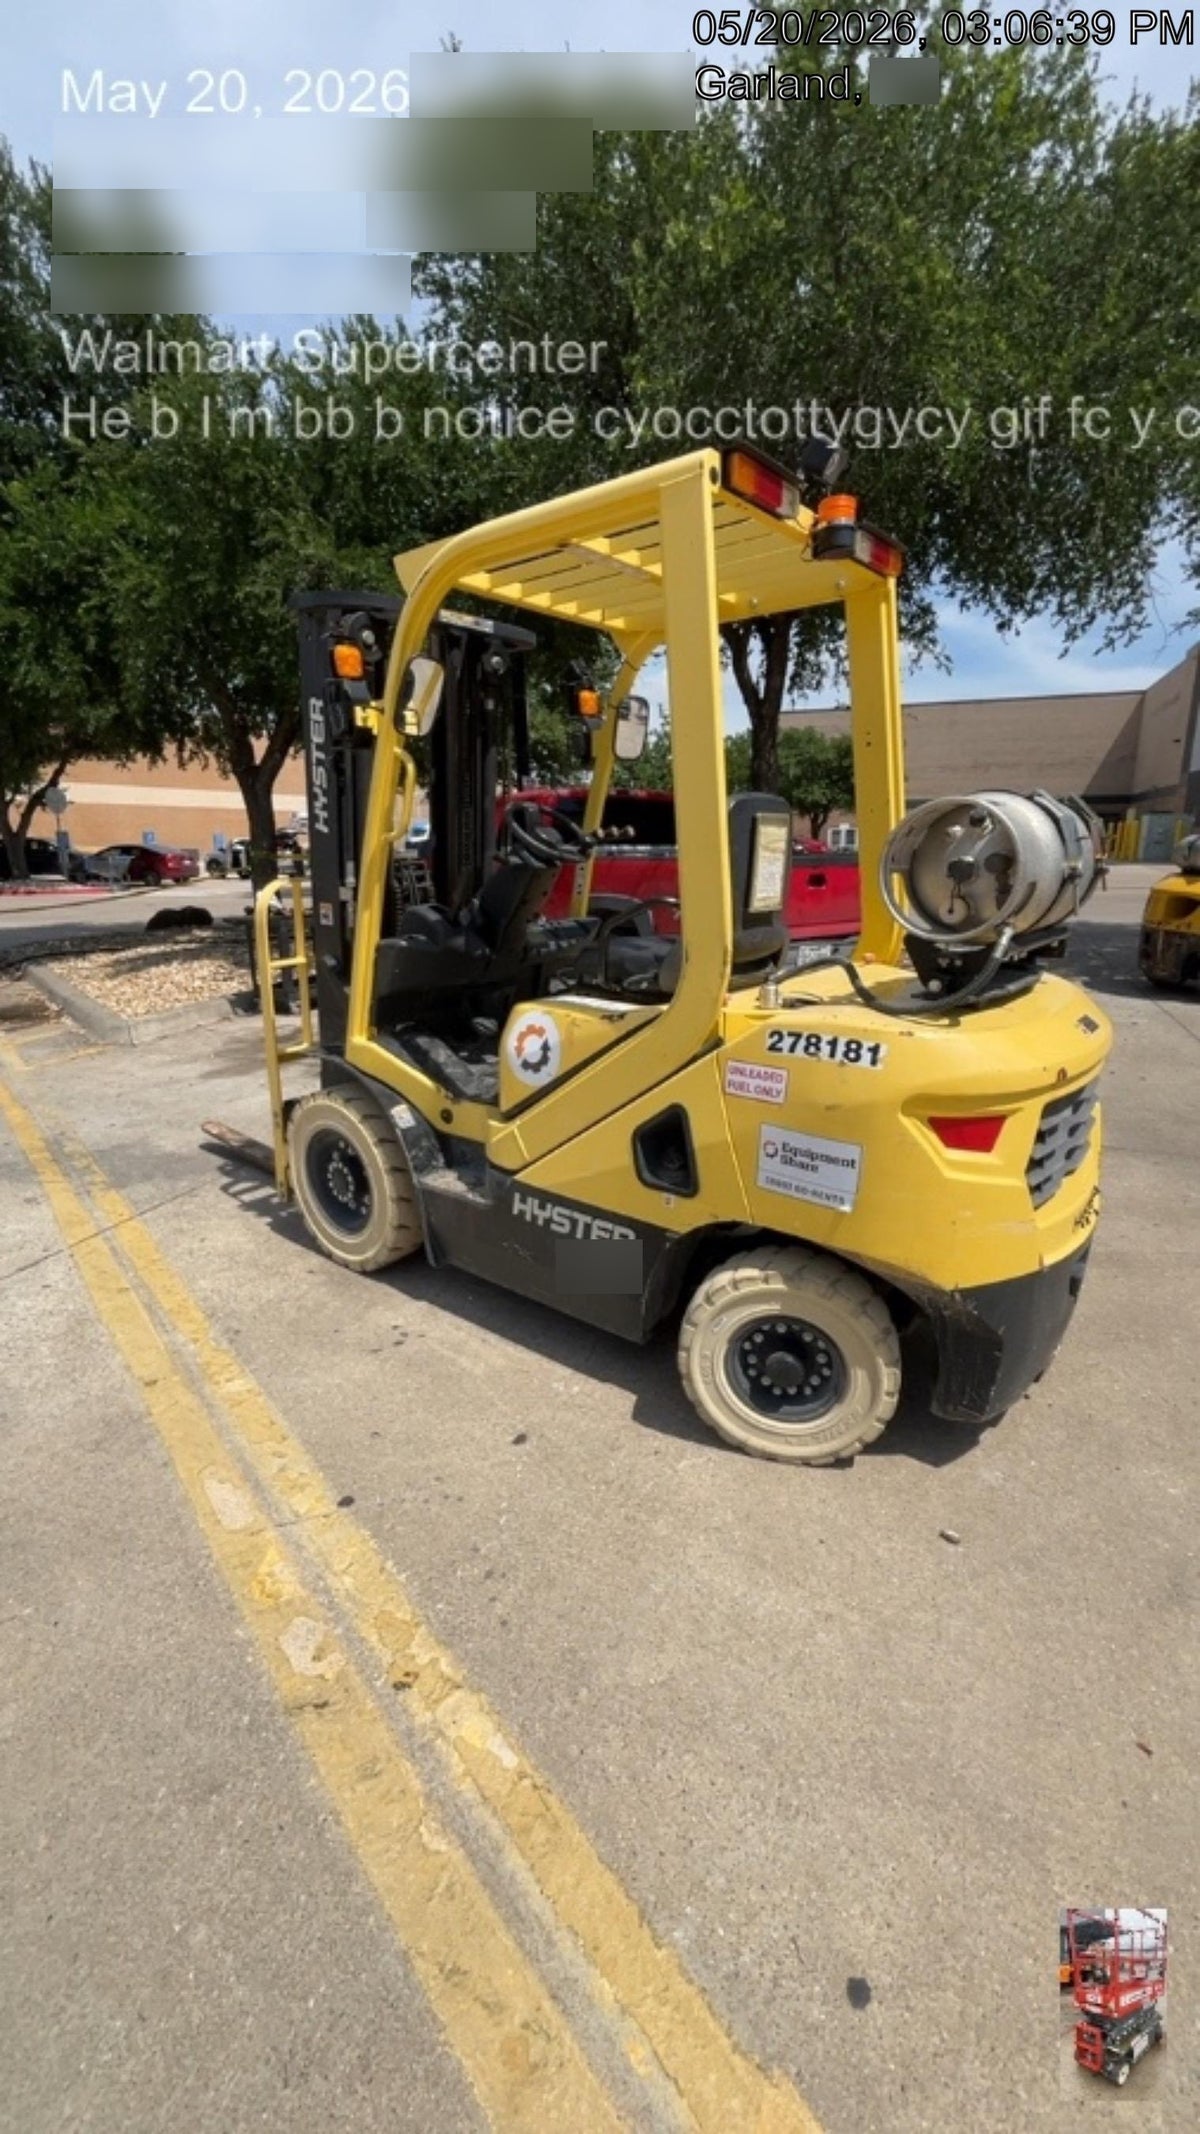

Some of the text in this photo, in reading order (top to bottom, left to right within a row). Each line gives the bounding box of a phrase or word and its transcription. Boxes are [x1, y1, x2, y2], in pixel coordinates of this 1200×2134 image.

[309, 697, 329, 833] HYSTER
[767, 1030, 881, 1067] 278181
[729, 1066, 783, 1084] UNLEADED
[728, 1078, 783, 1098] FUEL ONLY
[780, 1154, 819, 1173] Share
[782, 1141, 856, 1169] Equipment
